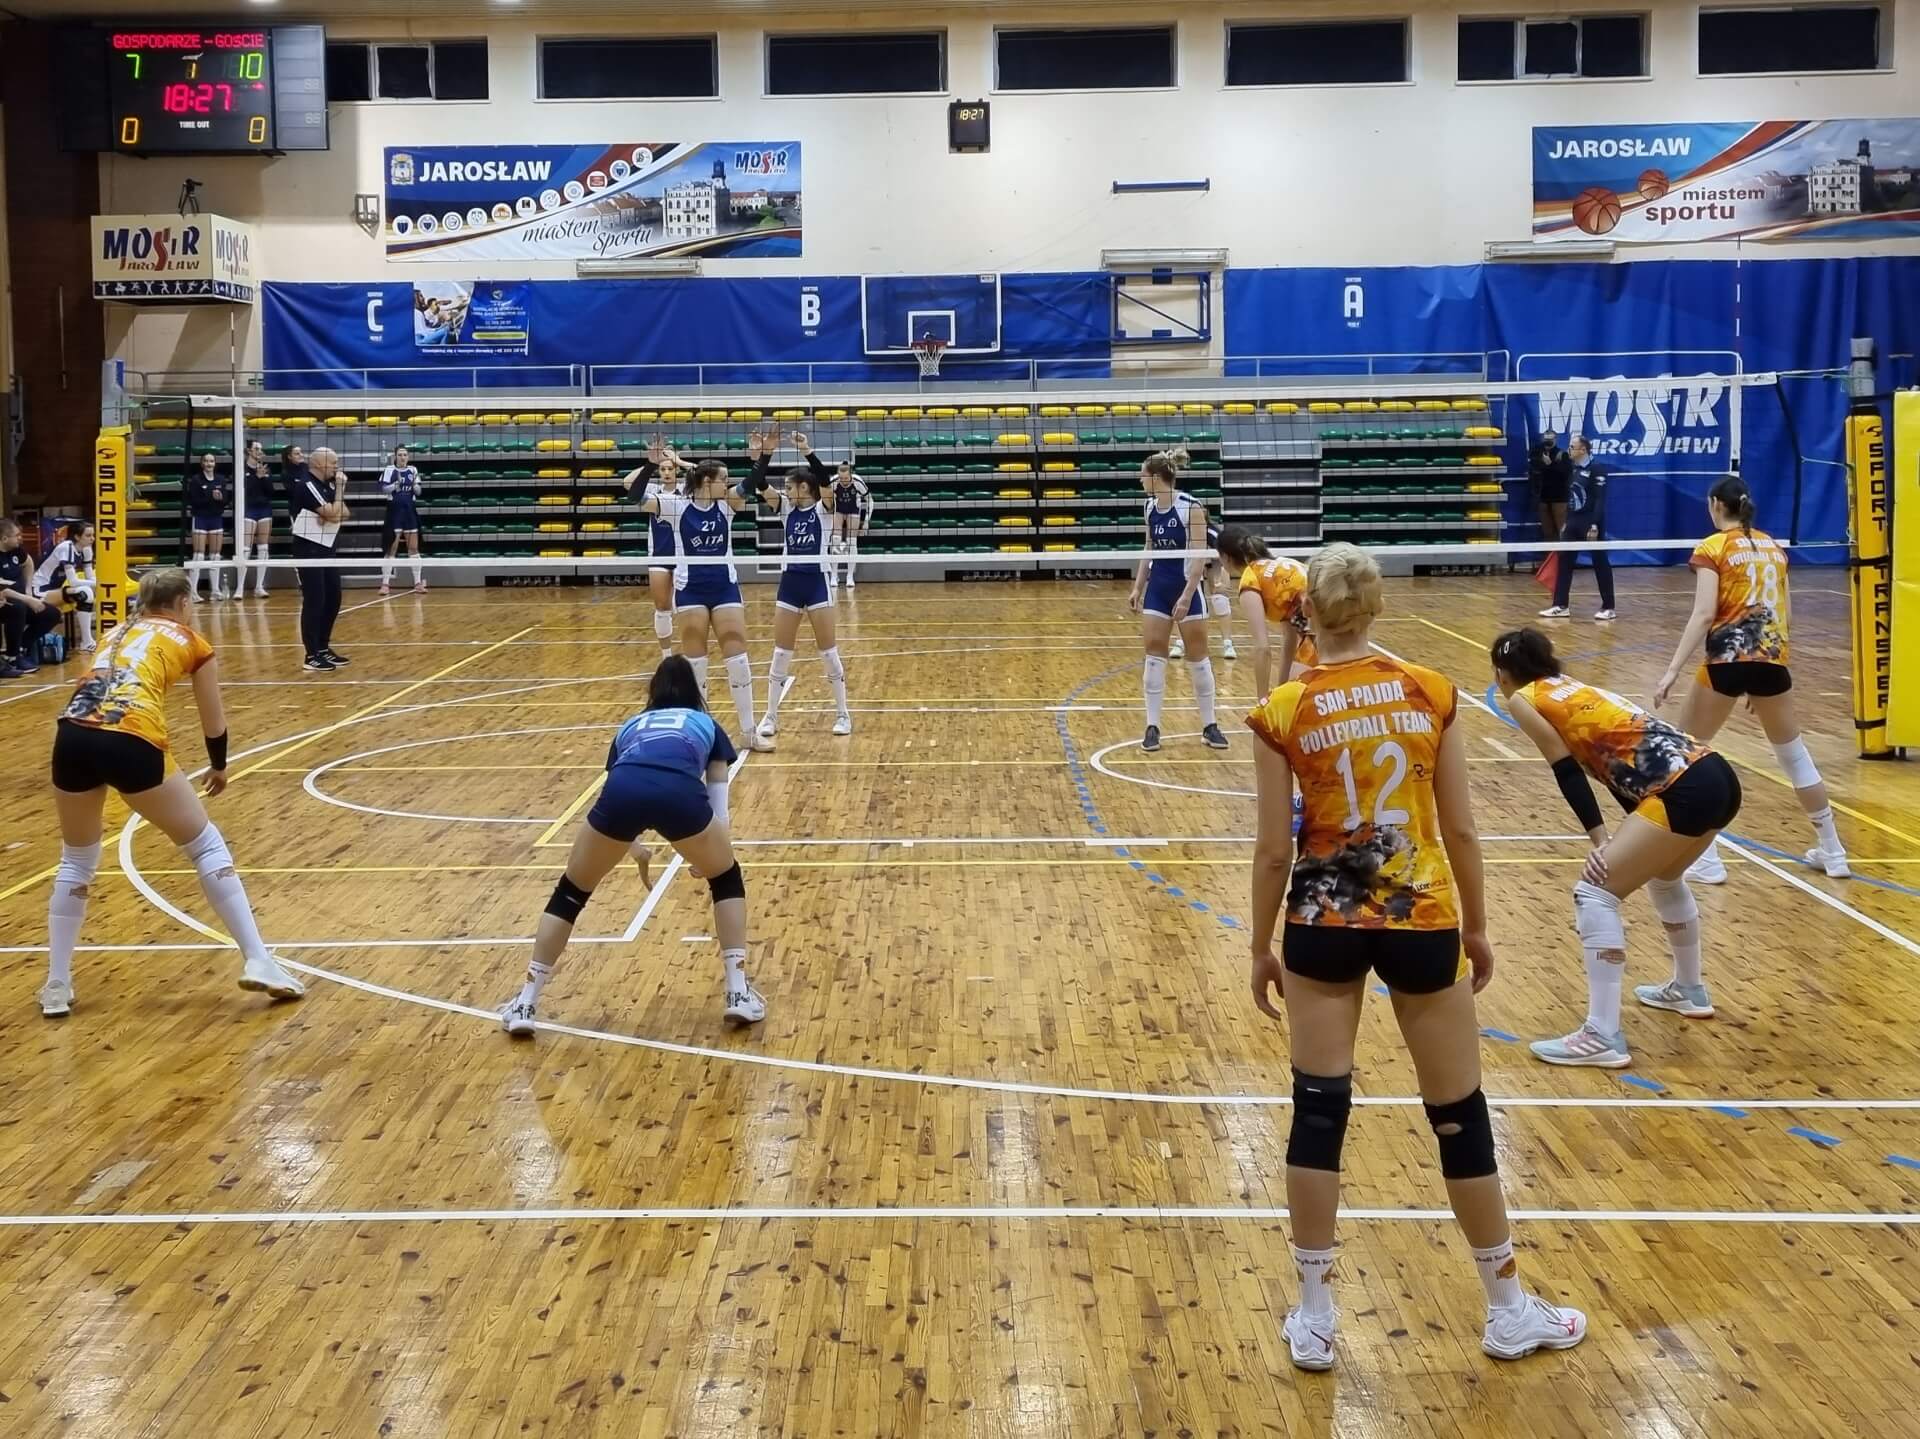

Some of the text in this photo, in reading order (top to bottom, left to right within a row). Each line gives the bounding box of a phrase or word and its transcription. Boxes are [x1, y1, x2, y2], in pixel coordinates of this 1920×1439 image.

[112, 34, 201, 48] GOSPODARZE
[126, 53, 140, 79] 7
[239, 53, 263, 79] 10
[163, 83, 232, 112] 18:27
[197, 121, 210, 129] OUT
[959, 108, 985, 121] 18:27
[121, 117, 139, 143] 0
[249, 116, 266, 143] 0
[1549, 137, 1691, 159] JAROSŁAW
[419, 161, 551, 182] JAROSŁAW
[1682, 186, 1766, 201] miastem
[1645, 203, 1736, 226] sportu
[801, 294, 820, 326] B
[1344, 284, 1364, 318] A
[367, 299, 384, 331] C
[1869, 442, 1886, 532] SPORT
[99, 465, 116, 550] SPORT
[701, 520, 717, 532] 27
[794, 522, 808, 535] 22
[797, 533, 816, 545] ITA
[1154, 525, 1165, 535] 16
[705, 534, 724, 545] ITA
[1745, 562, 1778, 608] 18
[1314, 680, 1405, 716] SAN-PAJDA
[1299, 711, 1433, 754] VOLLEYBALL TEAM
[1336, 741, 1410, 831] 12
